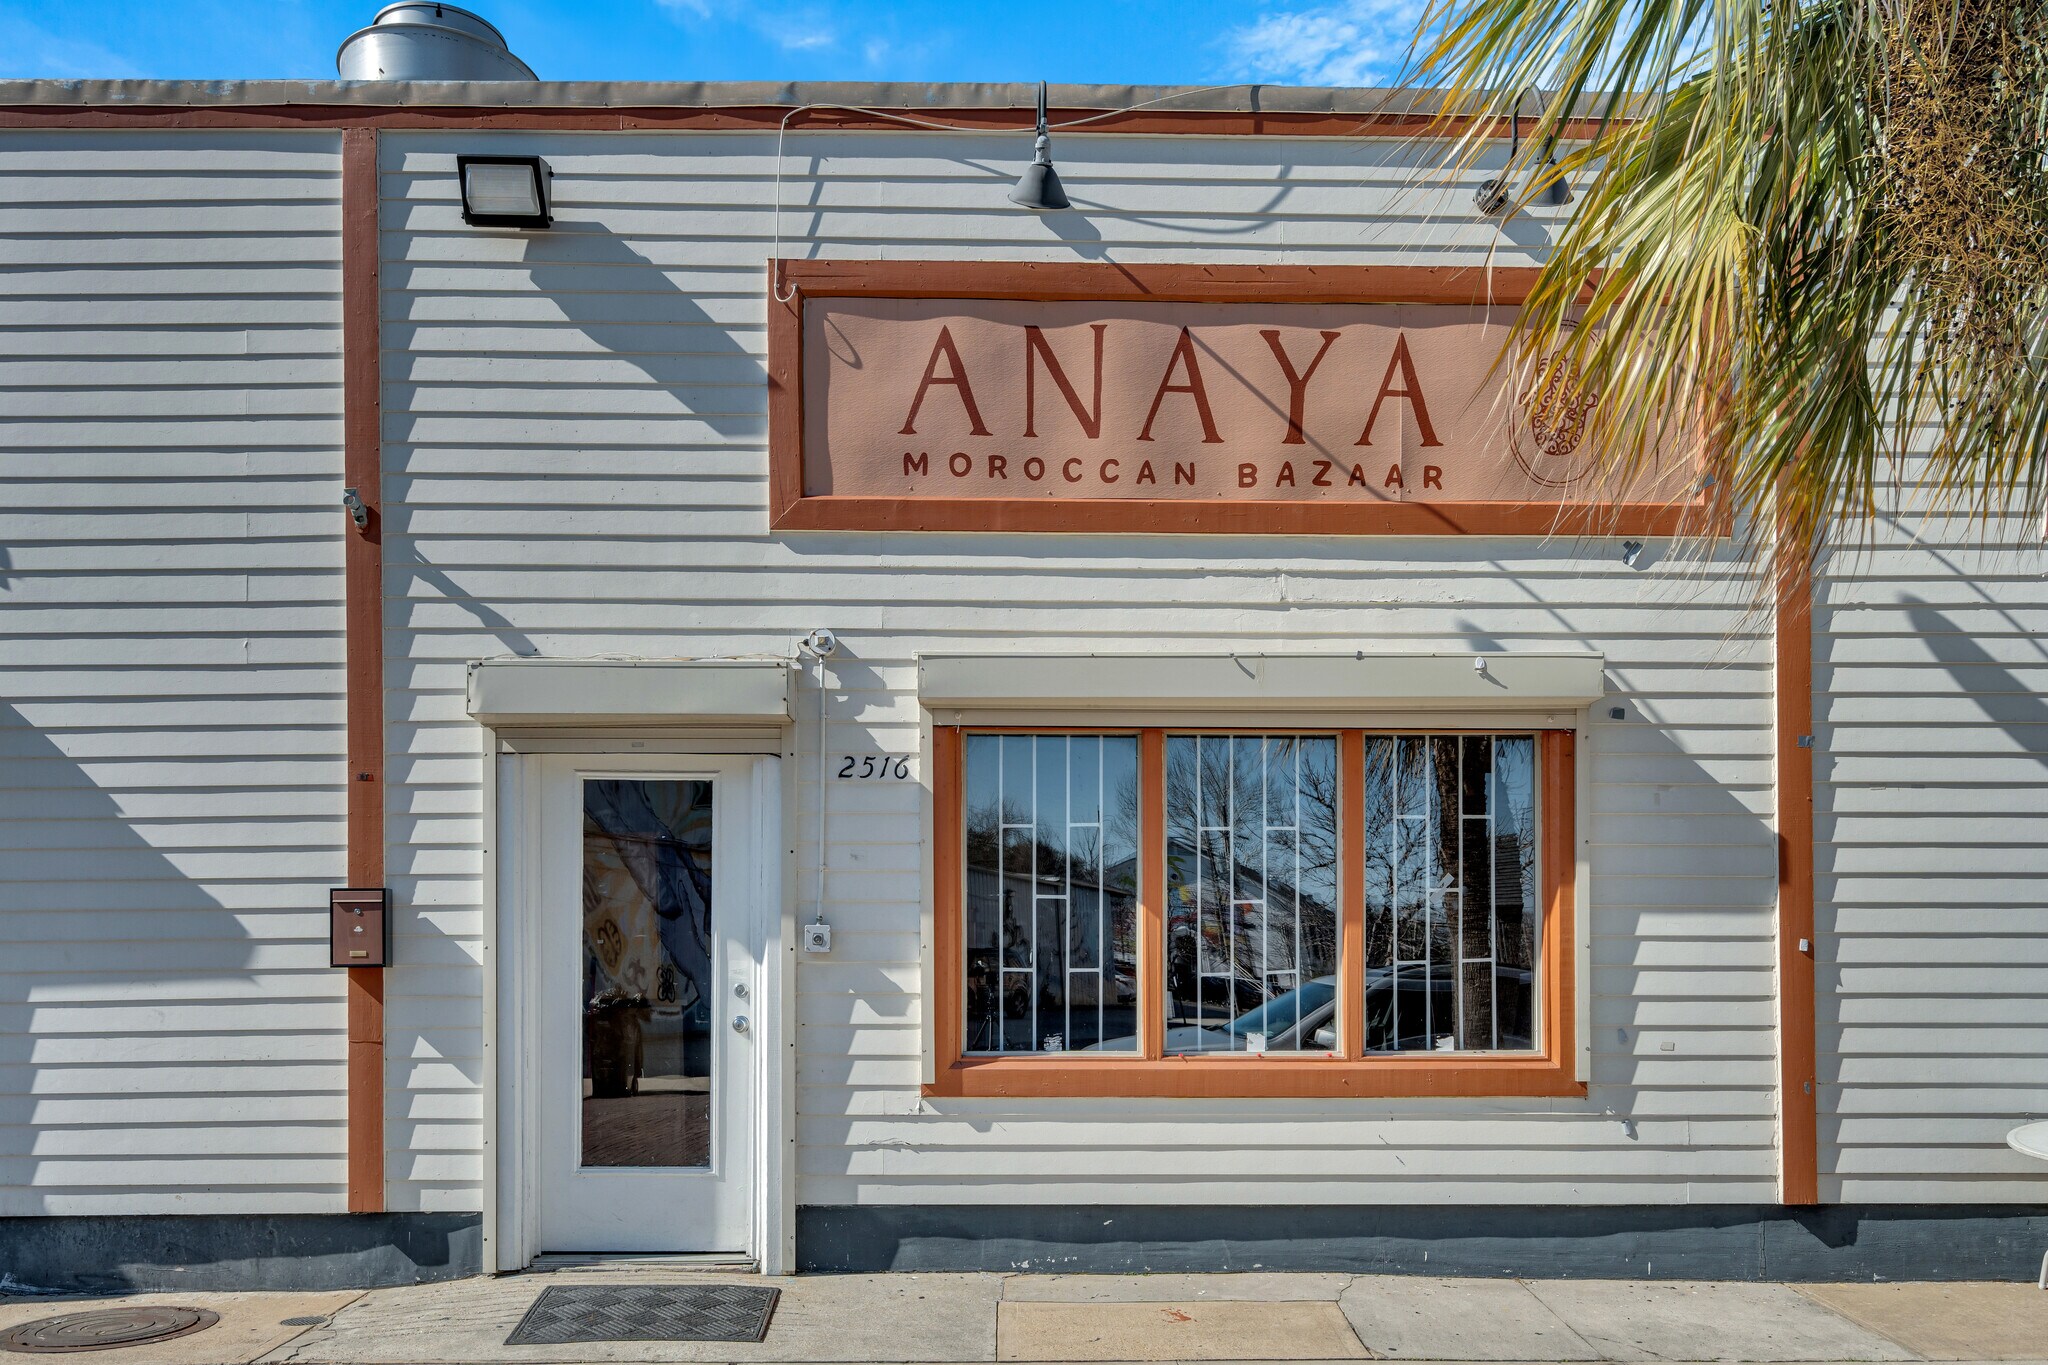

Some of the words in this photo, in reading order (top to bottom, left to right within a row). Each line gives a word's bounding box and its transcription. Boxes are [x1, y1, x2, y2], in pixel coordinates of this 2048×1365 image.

[898, 324, 1443, 447] ANAYA
[903, 452, 1196, 486] MOROCCAN
[1238, 461, 1443, 490] BAZAAR
[838, 755, 910, 779] 2516
